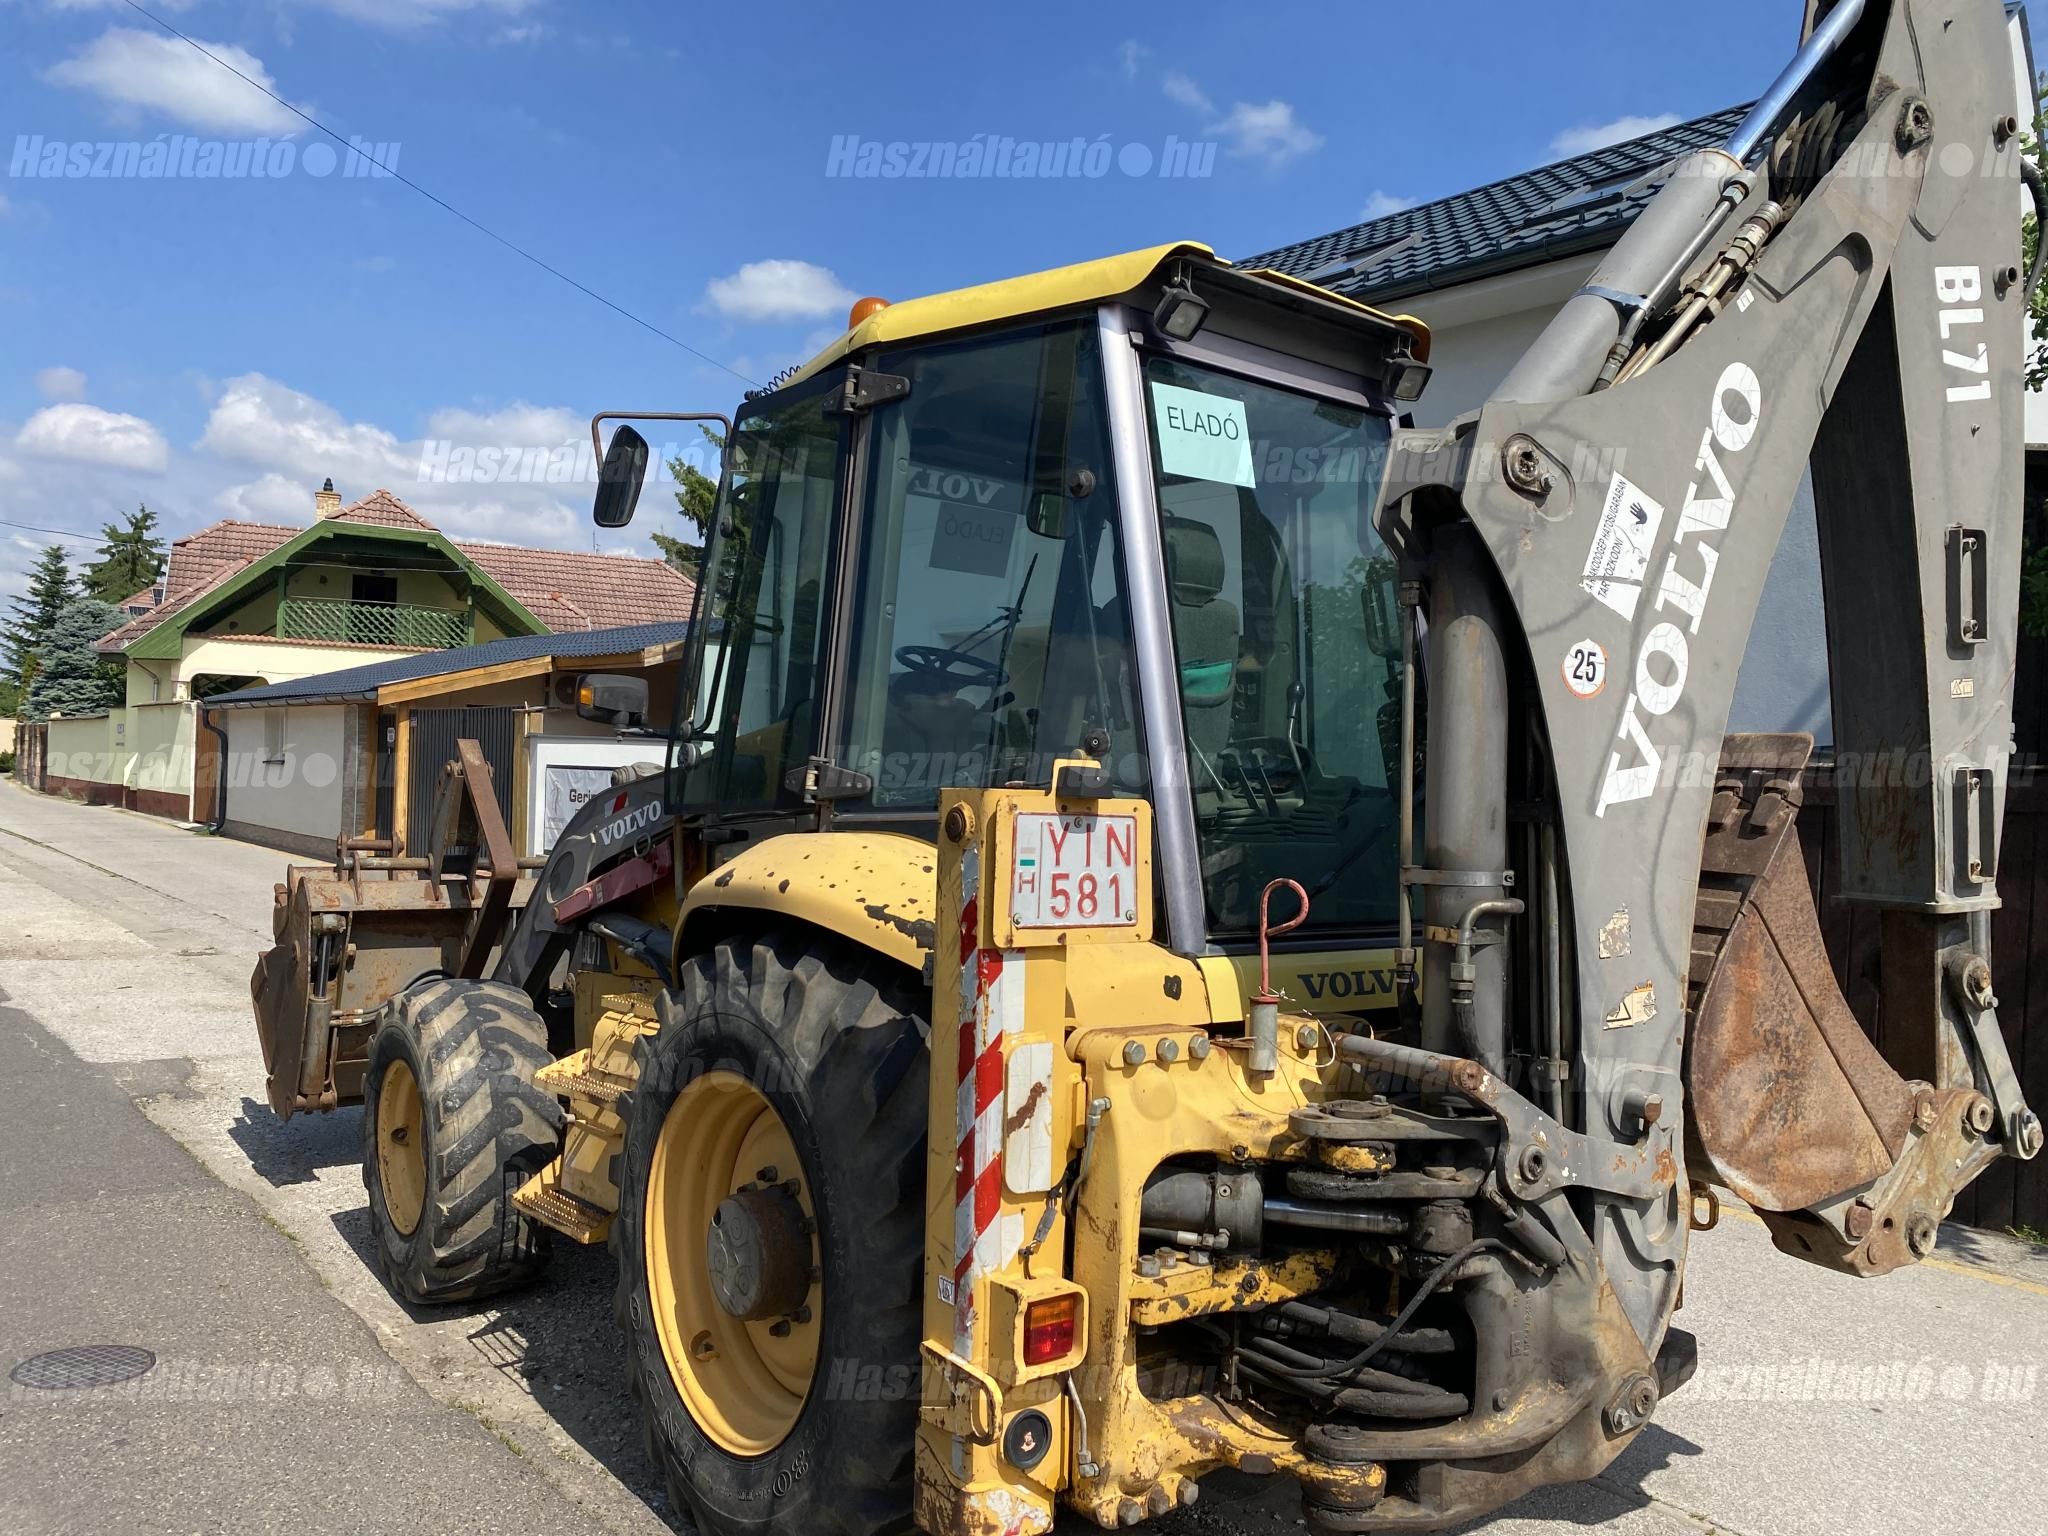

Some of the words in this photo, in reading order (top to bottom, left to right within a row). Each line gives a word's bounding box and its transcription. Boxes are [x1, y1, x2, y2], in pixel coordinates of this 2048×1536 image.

[1934, 266, 1991, 402] BL71
[1167, 406, 1239, 440] ELADÓ
[1595, 362, 1762, 818] VOLVO
[1572, 648, 1598, 683] 25
[599, 800, 662, 846] VOLVO
[1047, 822, 1131, 867] YIN
[1018, 871, 1036, 893] H
[1050, 873, 1121, 918] 581
